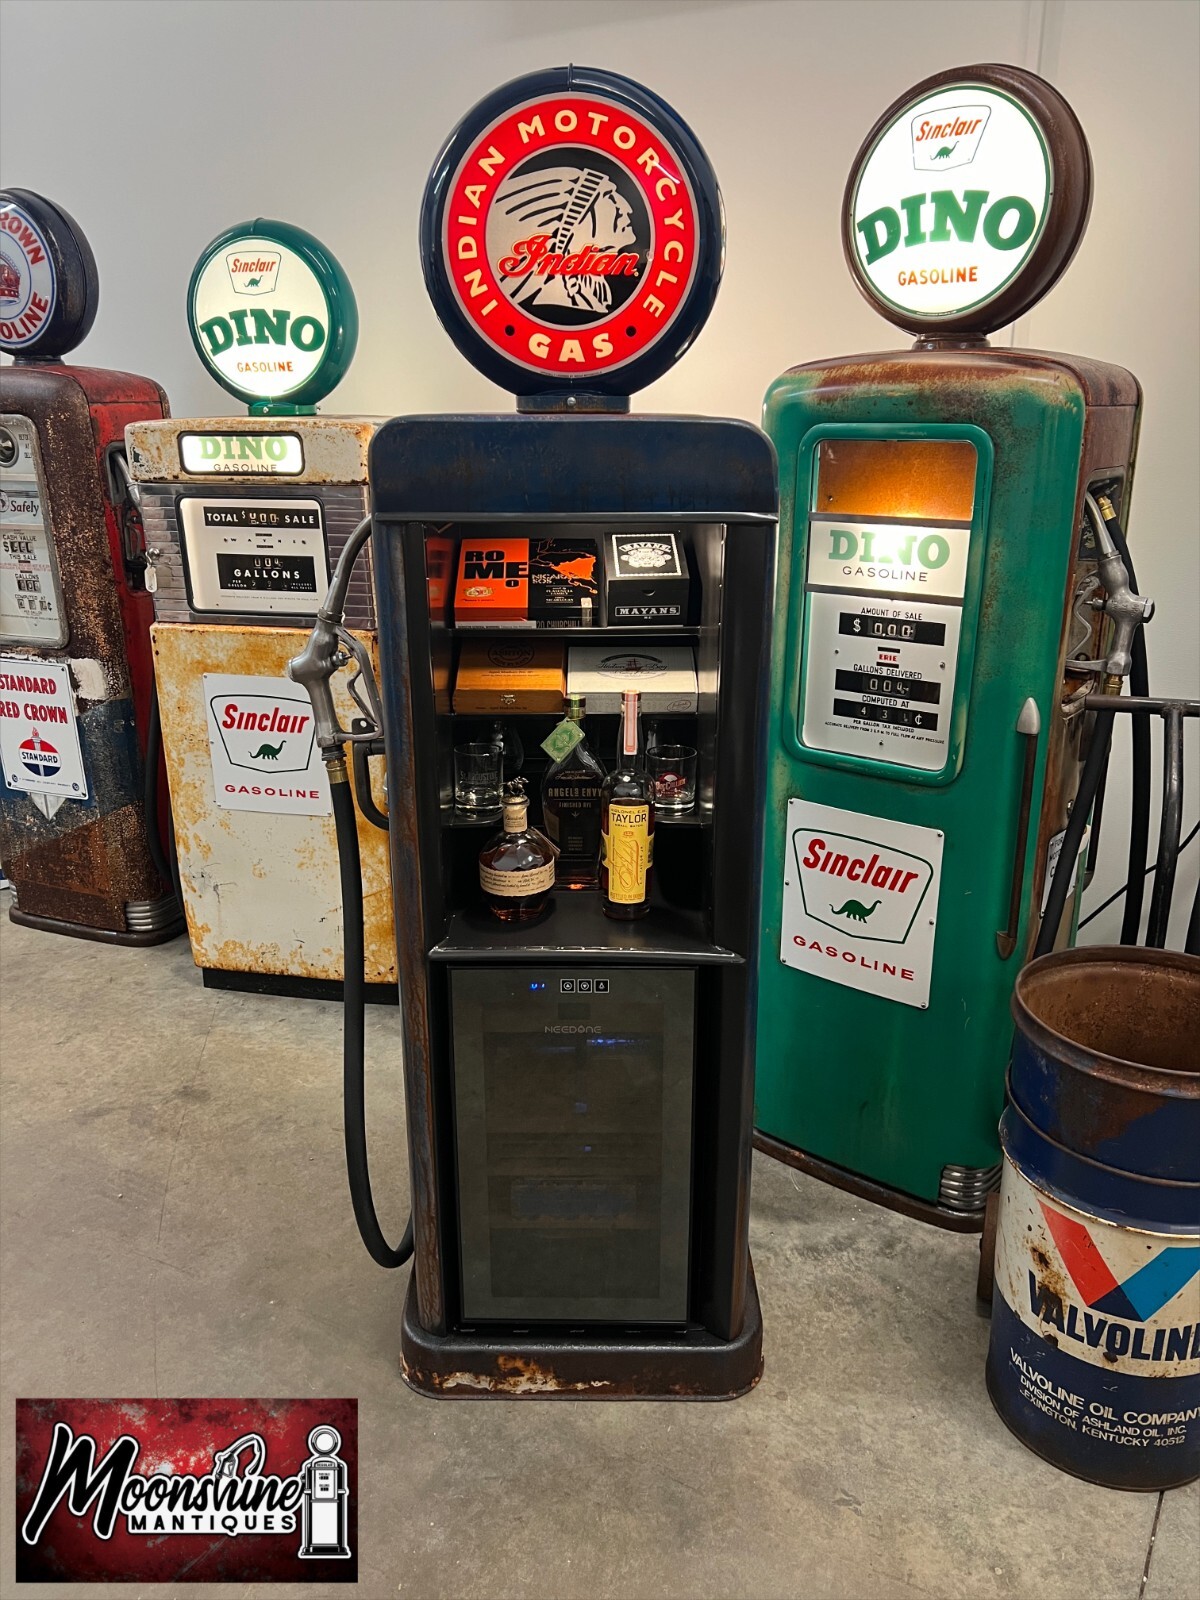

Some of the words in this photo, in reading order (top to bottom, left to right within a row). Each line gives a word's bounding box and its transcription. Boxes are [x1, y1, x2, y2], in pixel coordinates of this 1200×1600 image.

[915, 116, 983, 142] Sinclair
[457, 145, 506, 317] INDIAN
[517, 109, 685, 318] MOTORCYCLE
[856, 189, 1037, 266] DINO
[498, 232, 638, 278] Indian
[230, 257, 278, 274] Sinclair
[897, 265, 979, 287] GASOLINE
[199, 307, 326, 357] DINO
[528, 332, 614, 363] GAS
[236, 360, 294, 373] GASOLINE
[198, 435, 289, 462] DINO
[213, 463, 278, 473] GASOLINE
[10, 500, 40, 517] Safely
[206, 513, 239, 522] TOTAL
[284, 515, 315, 524] SALE
[827, 529, 951, 570] DINO
[234, 568, 300, 579] GALLONS
[842, 565, 929, 583] GASOLINE
[620, 607, 677, 615] MAYANS
[860, 607, 889, 617] AMOUNT
[892, 609, 901, 618] OF
[905, 611, 923, 621] SALE
[852, 617, 862, 633] $
[878, 653, 897, 662] ERIE
[853, 663, 884, 675] GALLONS
[886, 668, 922, 680] DELIVERED
[0, 673, 57, 695] STANDARD
[861, 694, 898, 707] COMPUTED
[900, 700, 910, 709] AT
[0, 701, 21, 719] RED
[23, 703, 69, 725] CROWN
[222, 703, 310, 734] Sinclair
[862, 720, 880, 728] GALLON
[892, 725, 915, 734] INCLUDED
[21, 751, 59, 764] STANDARD
[224, 784, 320, 799] GASOLINE
[581, 787, 603, 798] ENVY
[611, 812, 647, 824] TAYLOR
[802, 838, 919, 894] Sinclair
[792, 935, 915, 981] GASOLINE
[544, 1025, 602, 1034] NEEDONE
[1010, 1346, 1085, 1410] VALVOLINE
[1089, 1402, 1119, 1422] OIL
[1020, 1375, 1061, 1410] DIVISION
[1063, 1406, 1079, 1419] OF
[1081, 1412, 1140, 1436] ASHLAND
[1081, 1424, 1150, 1447] KENTUCKY
[1153, 1435, 1186, 1447] 40512
